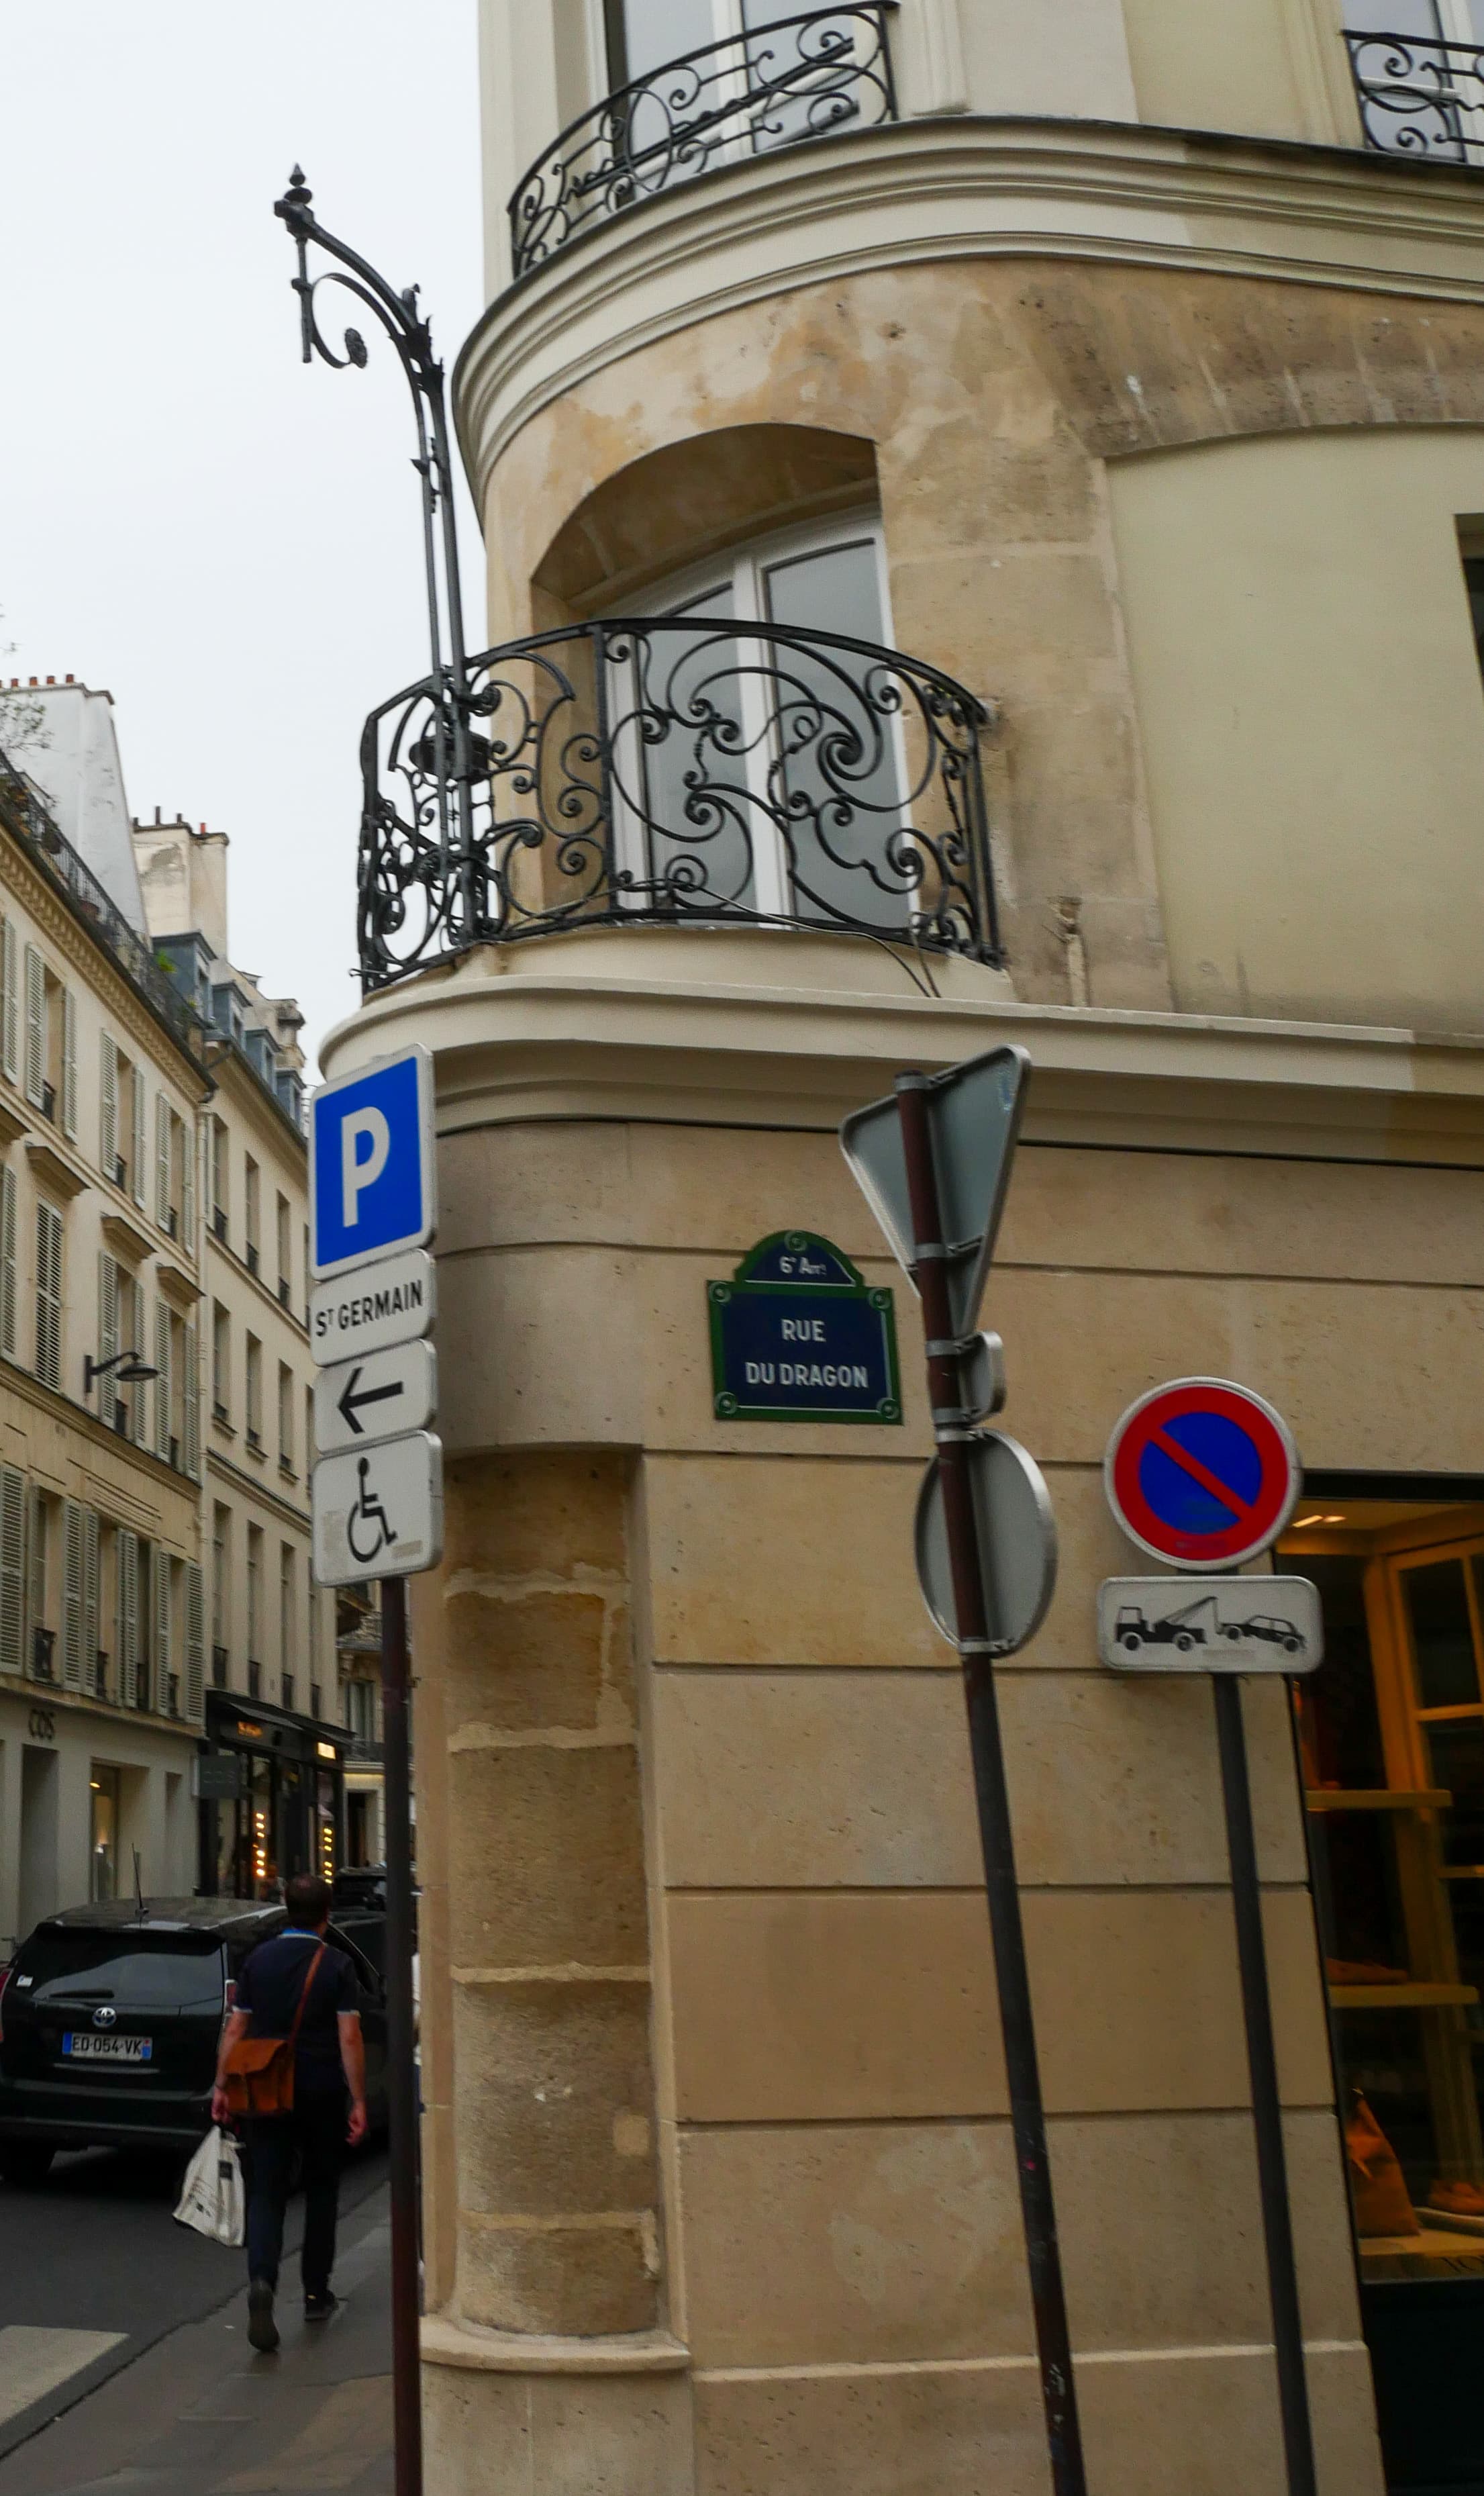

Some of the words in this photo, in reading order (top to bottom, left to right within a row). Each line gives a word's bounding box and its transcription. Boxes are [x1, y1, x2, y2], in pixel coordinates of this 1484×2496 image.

[340, 1106, 391, 1228] P
[338, 1280, 422, 1330] GERMAIN
[781, 1318, 826, 1342] RUE
[745, 1361, 775, 1384] DU
[779, 1363, 869, 1388] DRAGON
